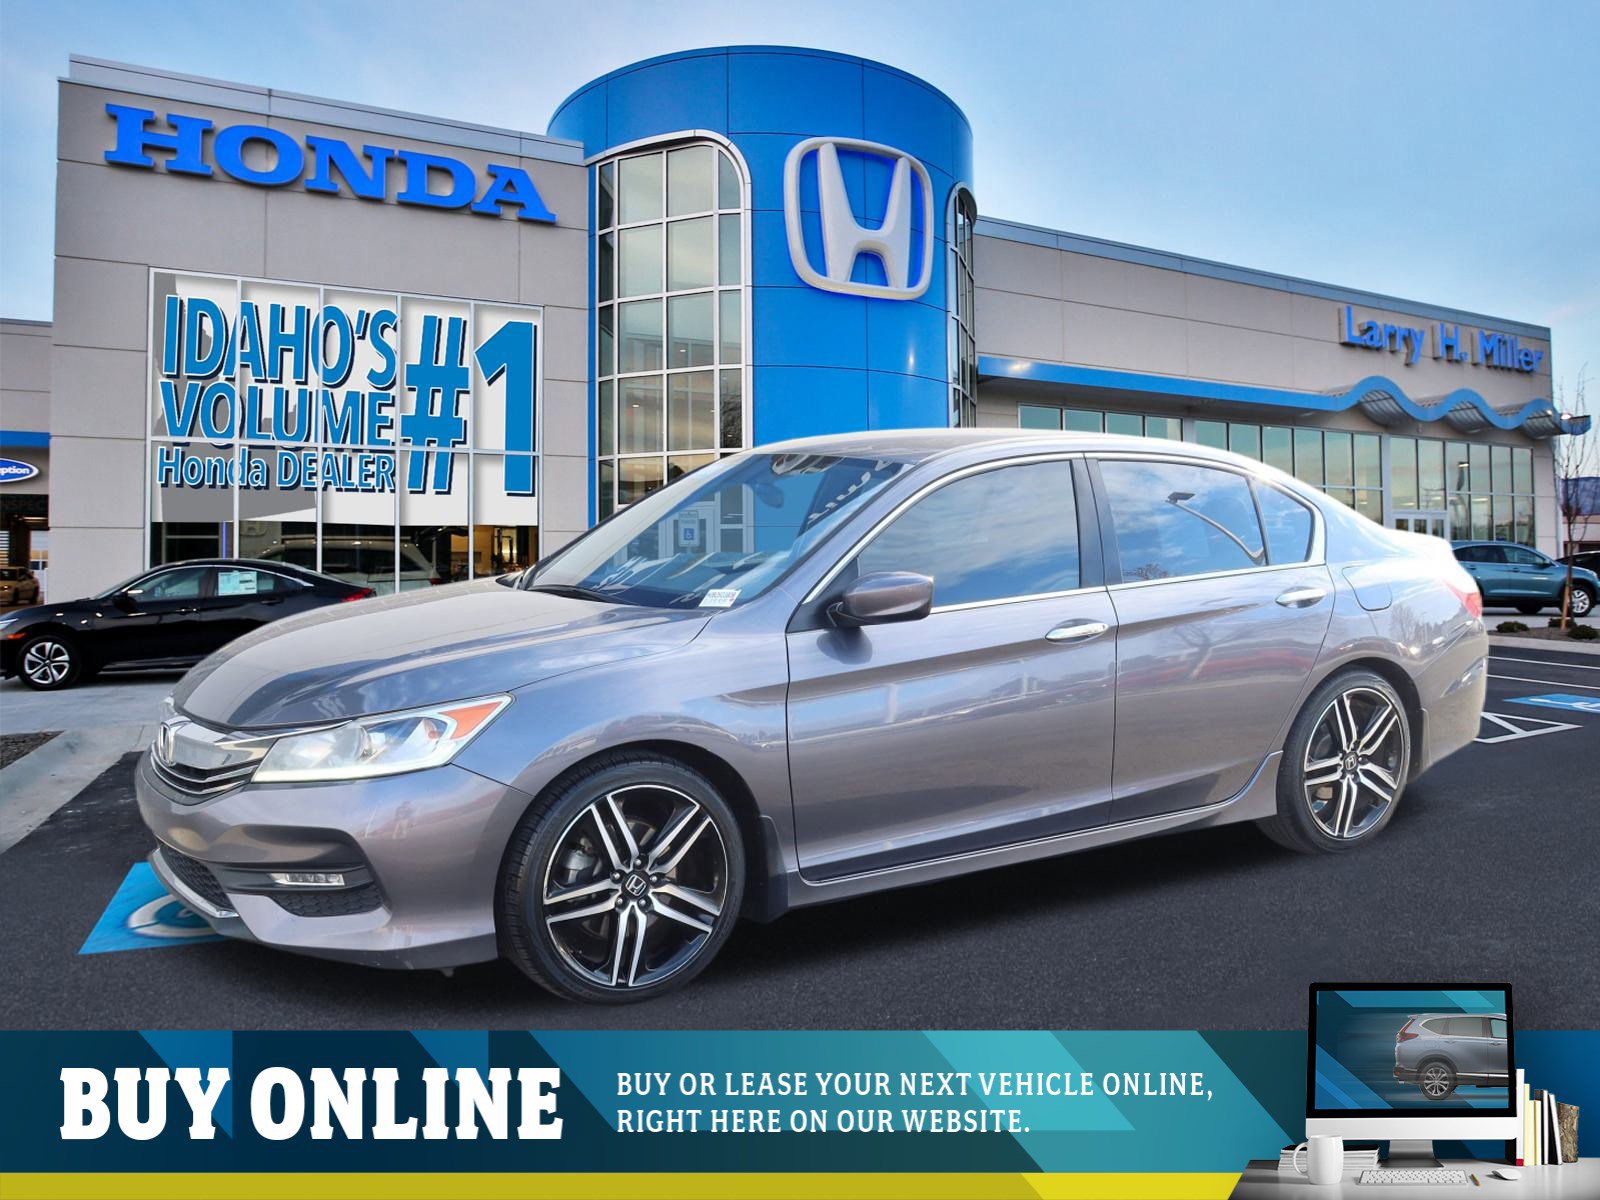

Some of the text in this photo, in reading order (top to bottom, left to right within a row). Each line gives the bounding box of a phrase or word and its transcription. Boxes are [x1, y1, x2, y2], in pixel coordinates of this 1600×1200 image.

[104, 103, 557, 224] HONDA
[161, 294, 399, 391] IDAHO'S
[1341, 305, 1544, 373] Larry H. Miller
[159, 379, 397, 453] VOLUME
[400, 314, 537, 497] #1
[157, 445, 397, 494] Honda DEALER
